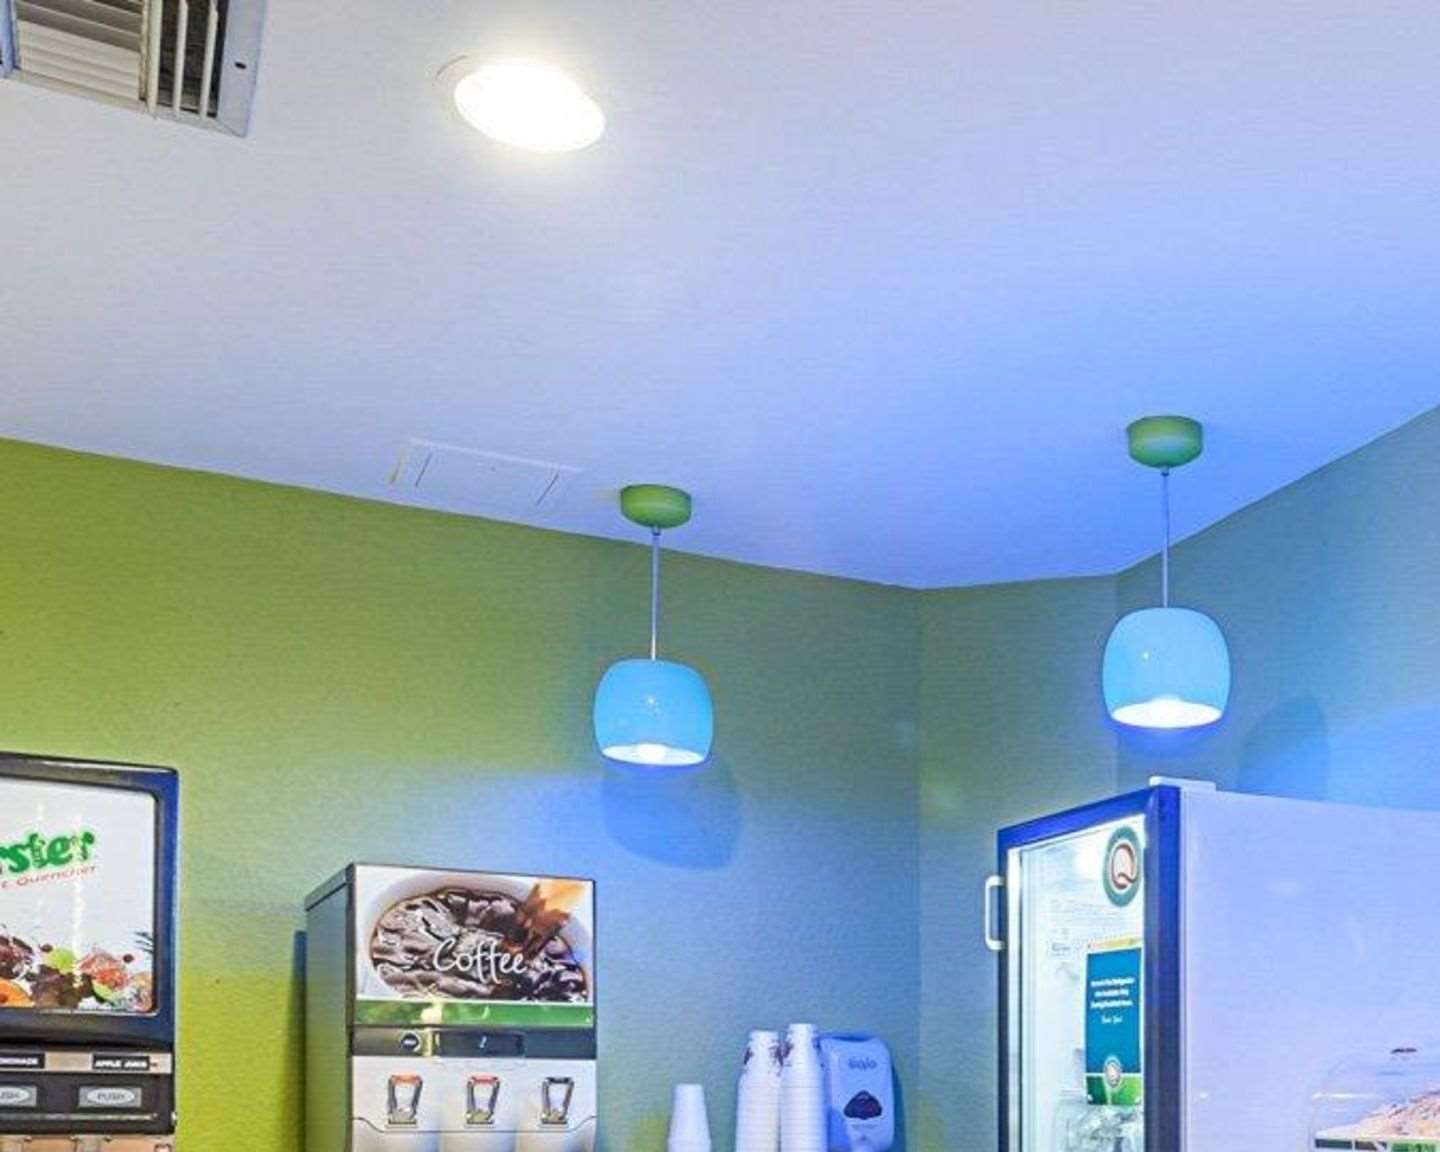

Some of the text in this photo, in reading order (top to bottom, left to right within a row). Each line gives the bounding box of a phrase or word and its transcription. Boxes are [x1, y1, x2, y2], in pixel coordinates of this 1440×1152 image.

[1110, 842, 1138, 891] Q
[433, 938, 526, 984] Coffee
[95, 1059, 122, 1068] APPLE
[97, 1091, 126, 1101] PUSH
